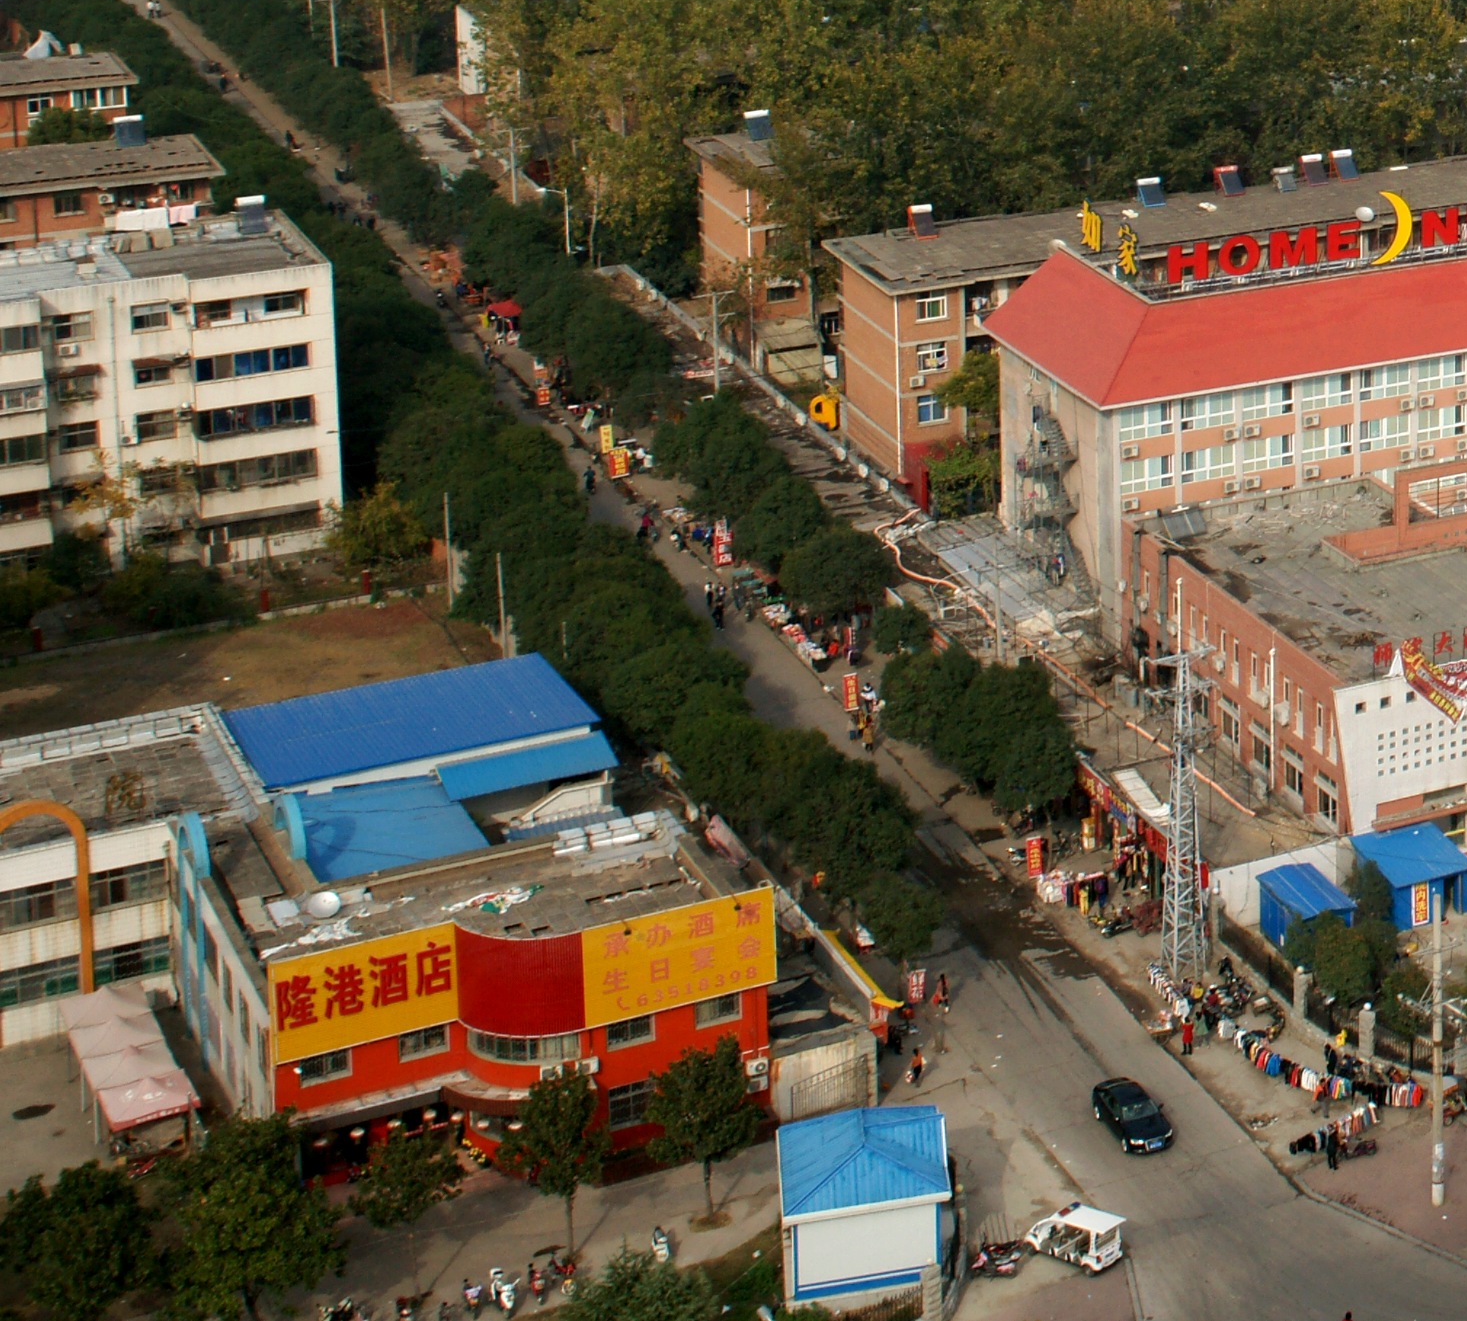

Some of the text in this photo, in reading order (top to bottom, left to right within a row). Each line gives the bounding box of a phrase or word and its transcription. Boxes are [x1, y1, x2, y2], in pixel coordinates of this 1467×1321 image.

[1167, 220, 1362, 284] HOME
[603, 902, 761, 959] 承办酒席
[276, 941, 453, 1031] 隆港酒店
[602, 935, 761, 995] 生日宴会
